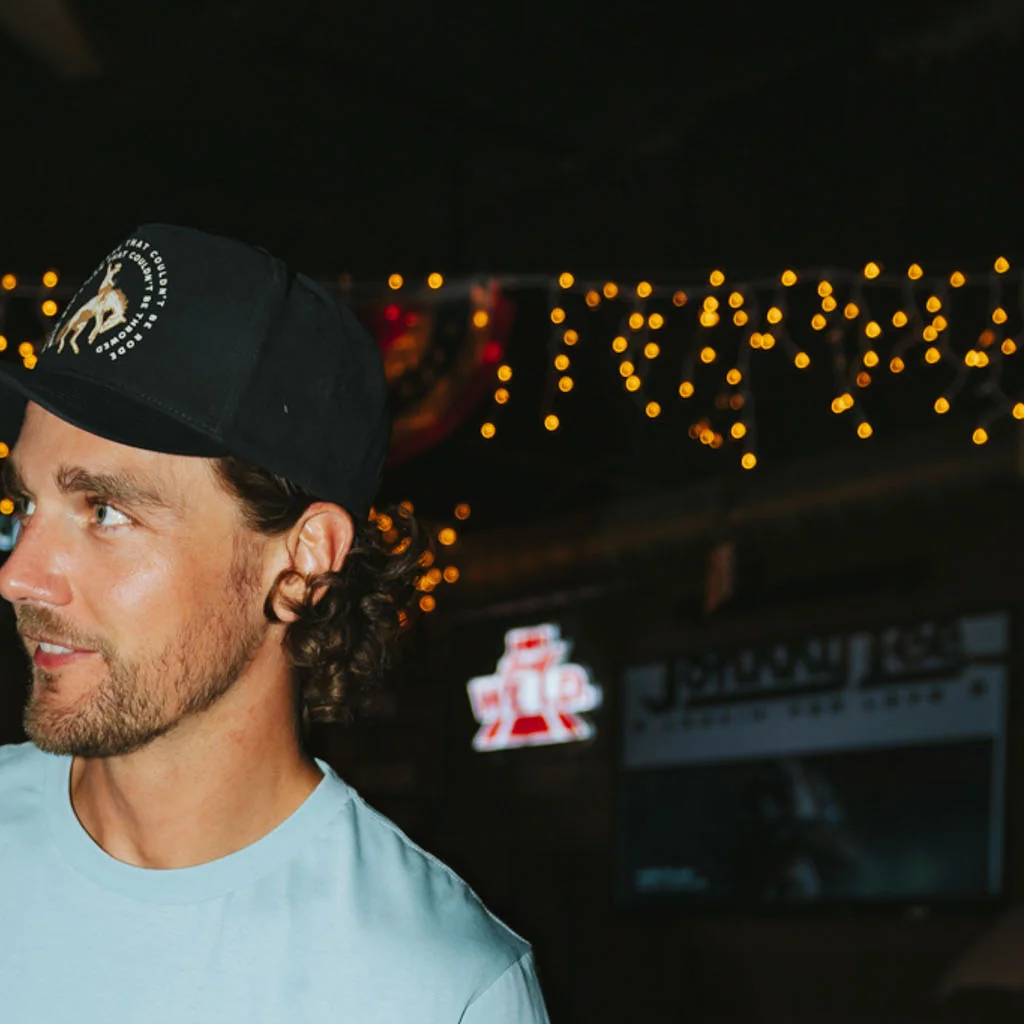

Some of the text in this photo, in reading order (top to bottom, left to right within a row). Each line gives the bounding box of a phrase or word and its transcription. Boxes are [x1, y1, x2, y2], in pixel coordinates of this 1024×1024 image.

[128, 251, 153, 292] COULDN'T
[150, 250, 169, 308] COULDN'T
[139, 295, 152, 311] BE
[95, 312, 144, 354] THROWED
[144, 315, 158, 330] BE
[109, 333, 144, 361] RODE
